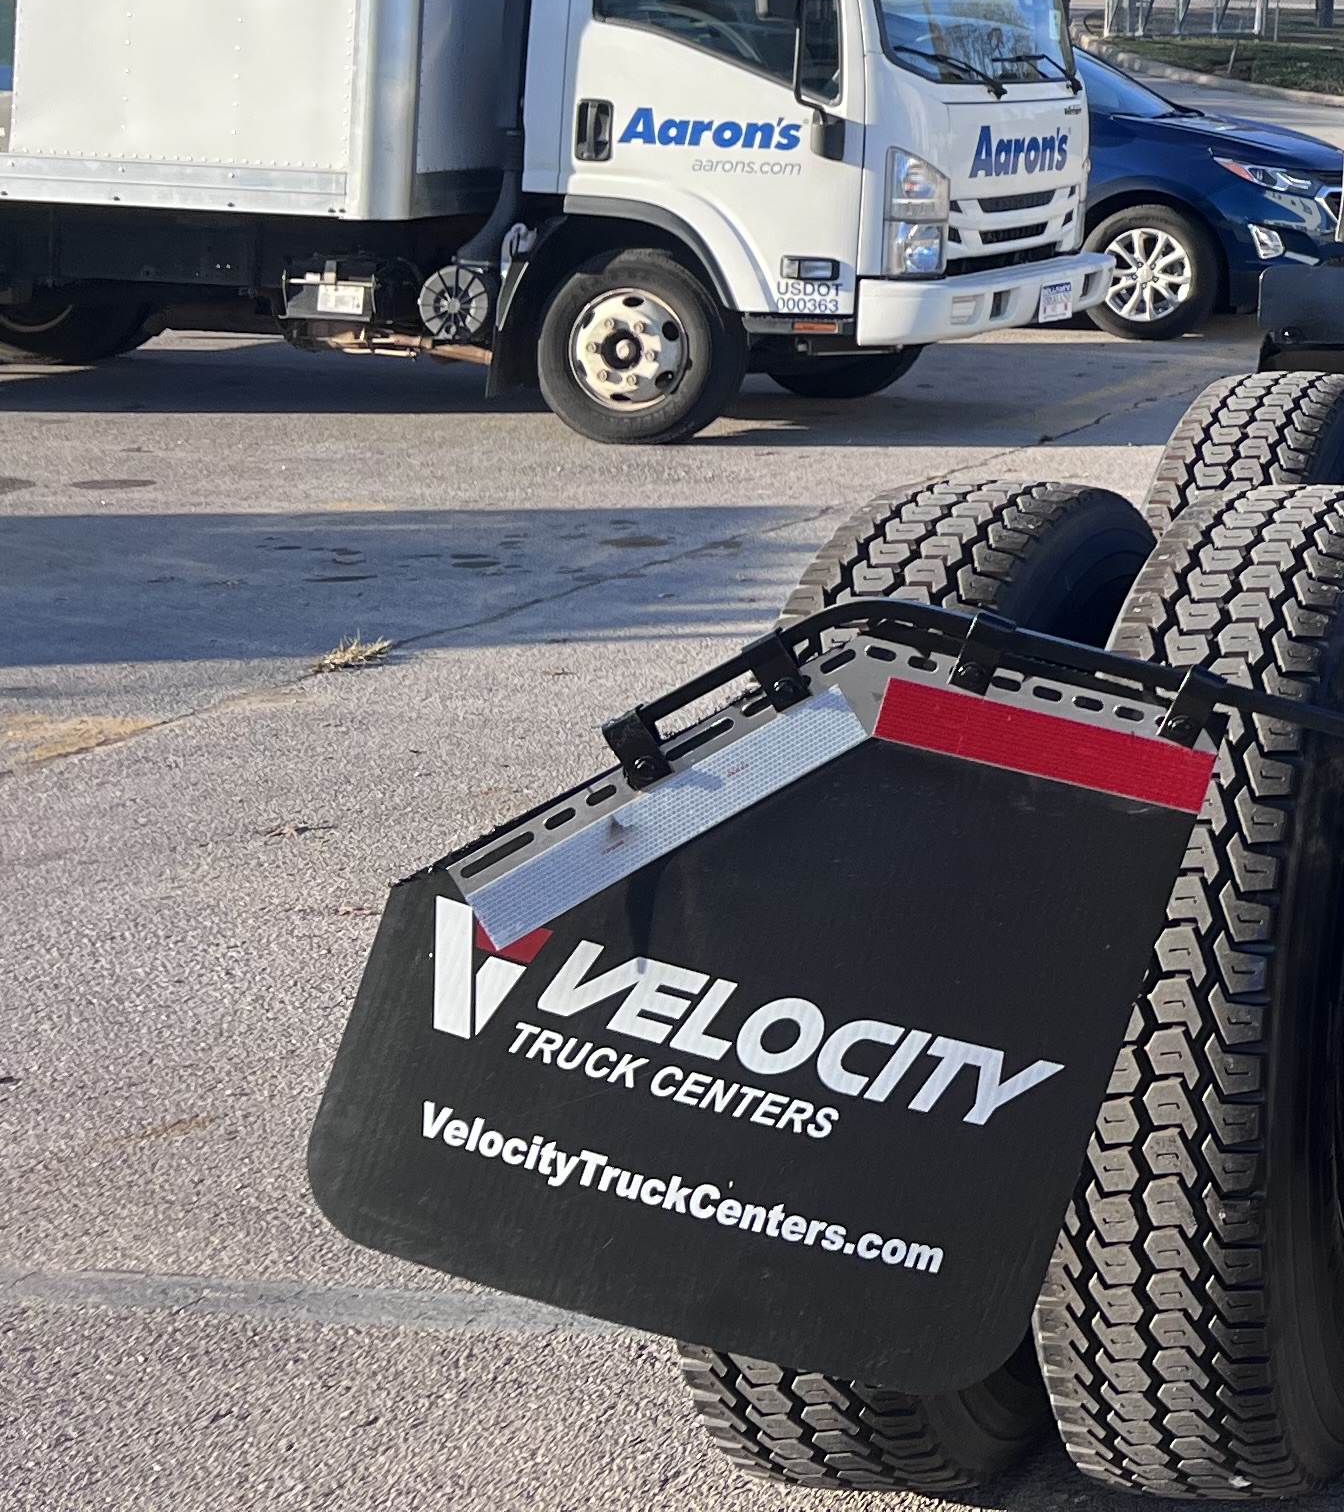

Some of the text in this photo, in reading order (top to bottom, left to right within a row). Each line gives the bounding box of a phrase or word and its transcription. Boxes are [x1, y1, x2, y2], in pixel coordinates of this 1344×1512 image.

[618, 107, 802, 151] Aaron's
[969, 125, 1068, 178] Aaron's
[691, 159, 802, 176] aarons.com
[776, 297, 840, 313] 000363
[777, 281, 843, 296] USDOT
[538, 940, 1064, 1125] VELOCITY
[508, 1021, 840, 1139] TRUCK CENTERS
[422, 1100, 944, 1274] VelocityTruckCenters.com
